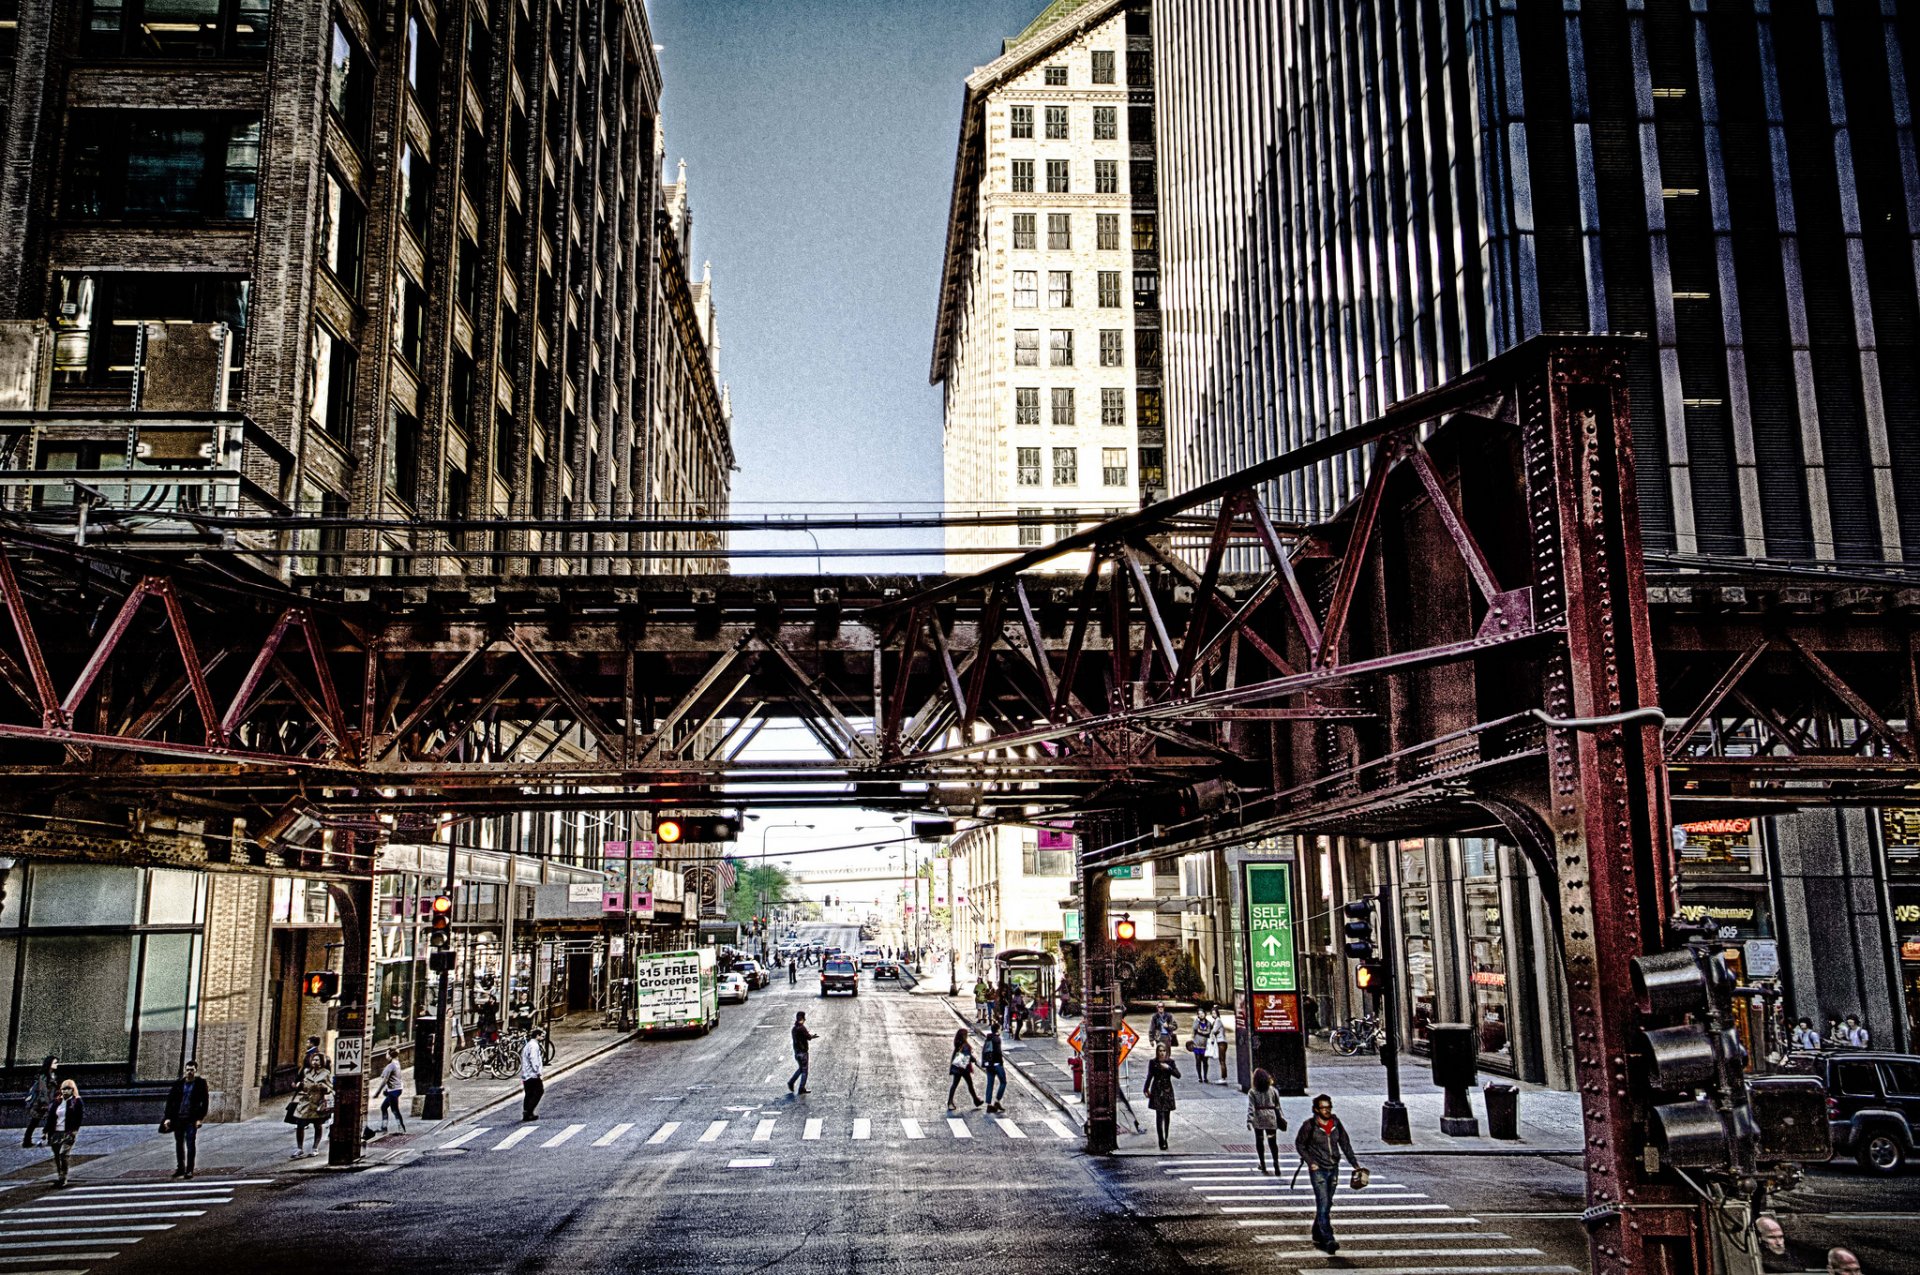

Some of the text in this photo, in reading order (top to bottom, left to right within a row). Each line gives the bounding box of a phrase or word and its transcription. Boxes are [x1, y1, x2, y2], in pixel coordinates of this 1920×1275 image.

[1681, 818, 1750, 833] HARMACY
[1252, 906, 1287, 918] SELF
[1253, 919, 1288, 930] PARK
[1271, 960, 1290, 968] CARS
[640, 967, 661, 977] $15
[664, 965, 698, 976] FREE
[639, 976, 699, 988] Groceries
[338, 1040, 360, 1050] ONE
[337, 1050, 361, 1060] WAY
